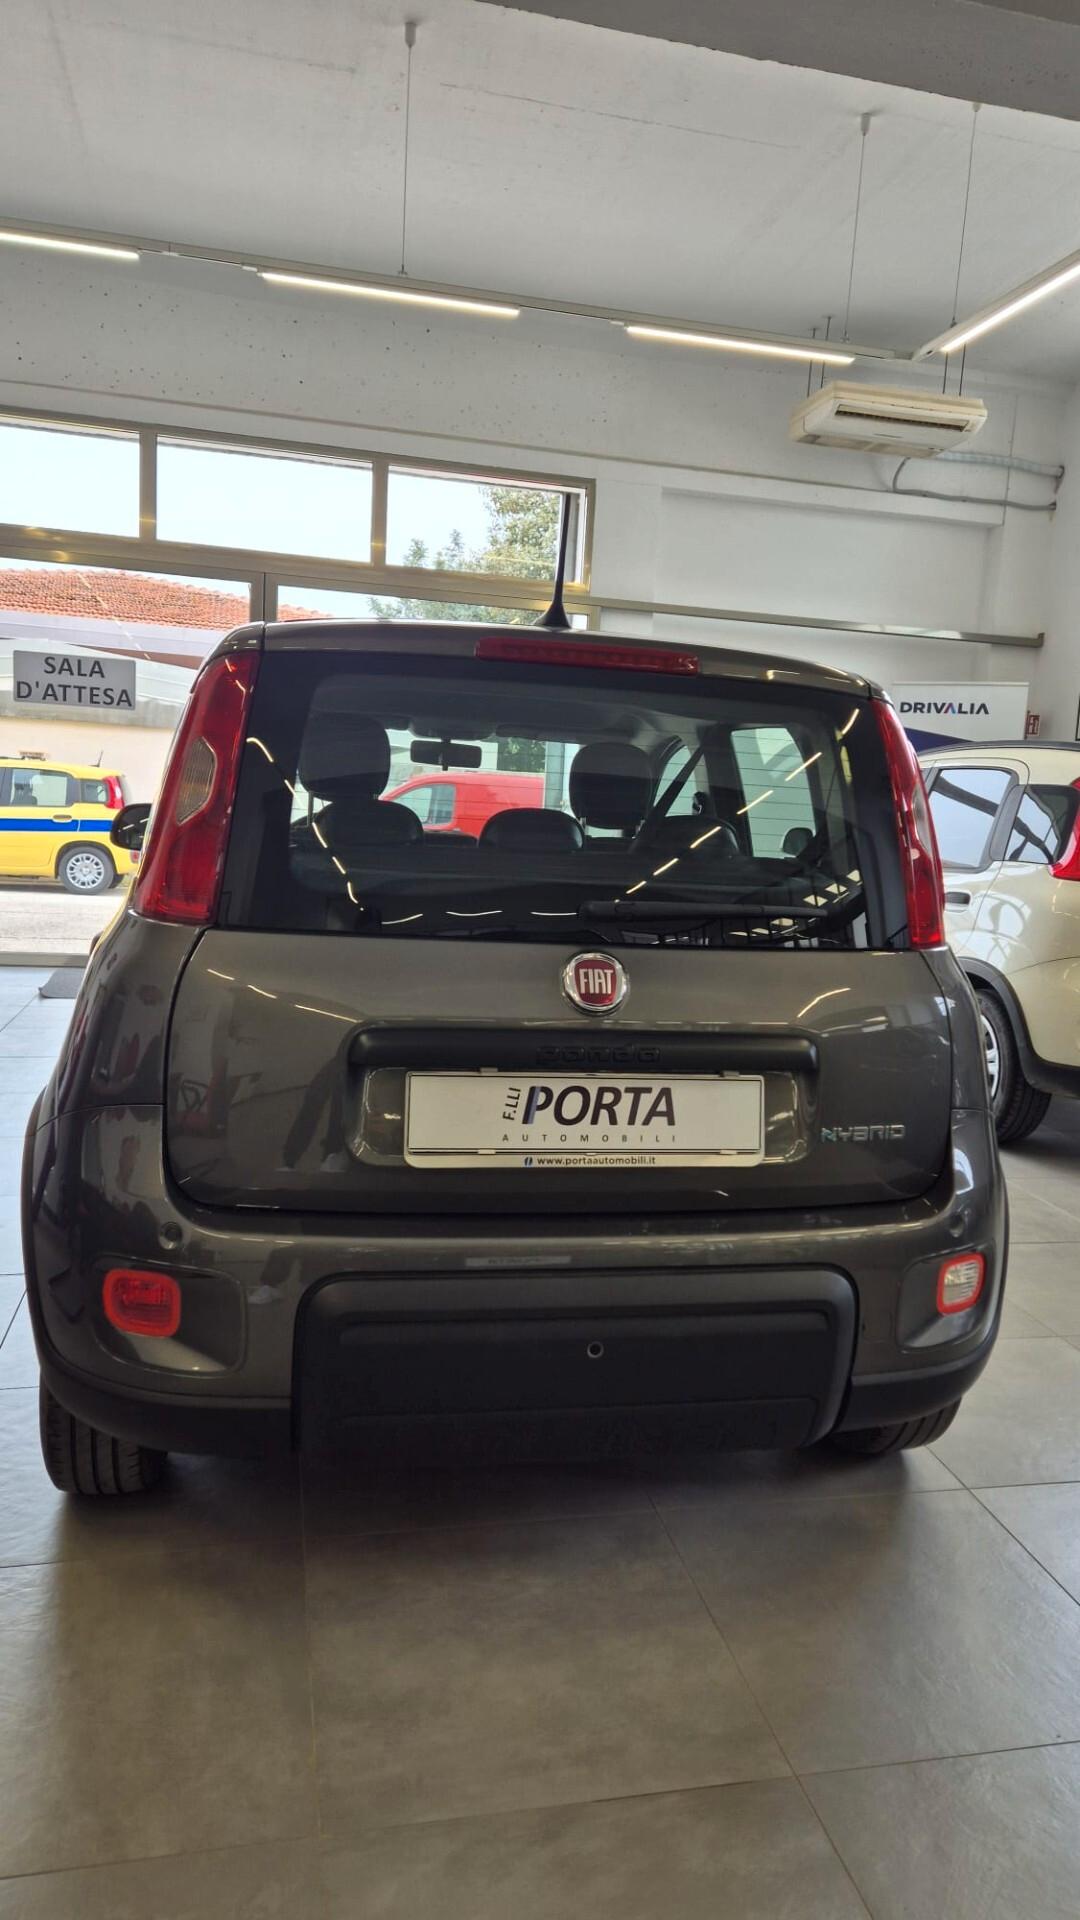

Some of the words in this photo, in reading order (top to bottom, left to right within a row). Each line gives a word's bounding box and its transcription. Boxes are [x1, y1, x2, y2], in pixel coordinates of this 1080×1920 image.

[44, 656, 105, 678] SALA
[16, 680, 132, 707] D'ATTESA
[900, 702, 989, 715] DRIVALIA
[579, 968, 613, 994] FIAT
[502, 1087, 521, 1121] F.LLI
[522, 1085, 676, 1126] PORTA
[502, 1134, 676, 1143] AUTOMOBILI
[537, 1156, 656, 1166] www.portaautomobili.it
